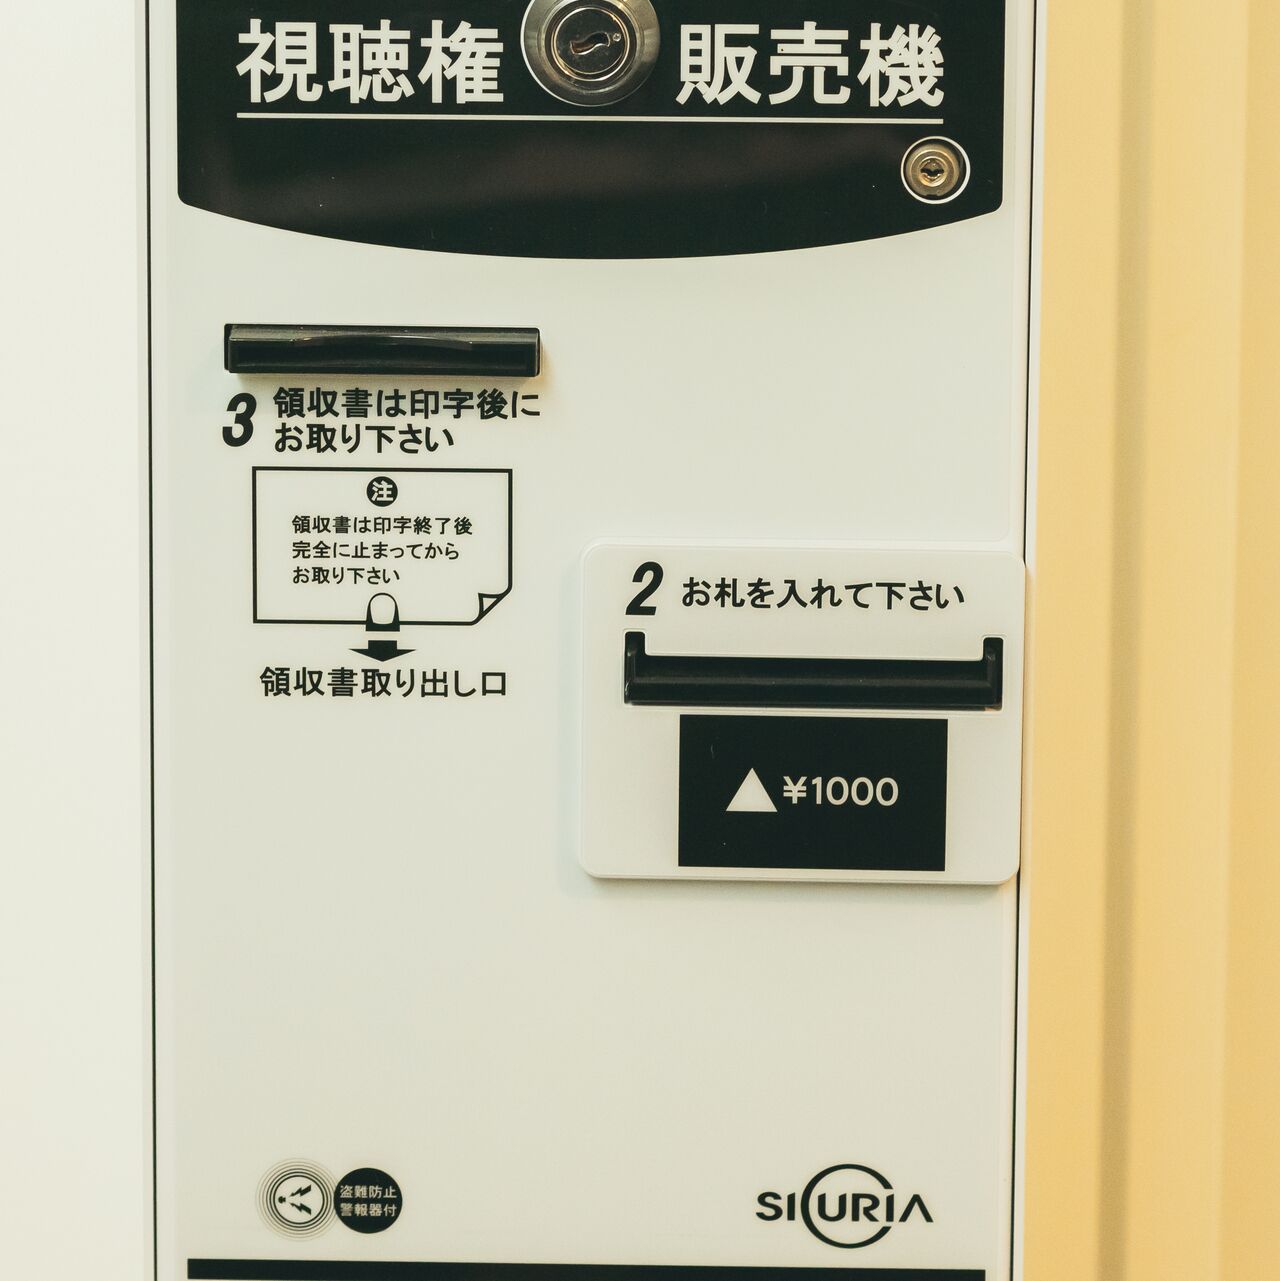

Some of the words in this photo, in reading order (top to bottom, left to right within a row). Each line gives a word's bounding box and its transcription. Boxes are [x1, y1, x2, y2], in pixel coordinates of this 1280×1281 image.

[235, 18, 504, 104] 視聴権
[675, 20, 945, 107] 販売機
[222, 392, 258, 448] 3
[272, 386, 541, 420] 領収書は印字後に
[274, 422, 455, 454] お取り下さい
[291, 514, 473, 536] 領収書は印字終了後
[292, 540, 459, 560] 完全に止まってから
[292, 565, 400, 585] お取り下さい
[625, 561, 664, 616] 2
[681, 576, 965, 611] お札を入れて下さい
[259, 666, 506, 698] 領収書取り出し口
[783, 775, 899, 807] ¥1000
[339, 1183, 399, 1199] 盗難防止
[340, 1202, 397, 1217] 警報器付
